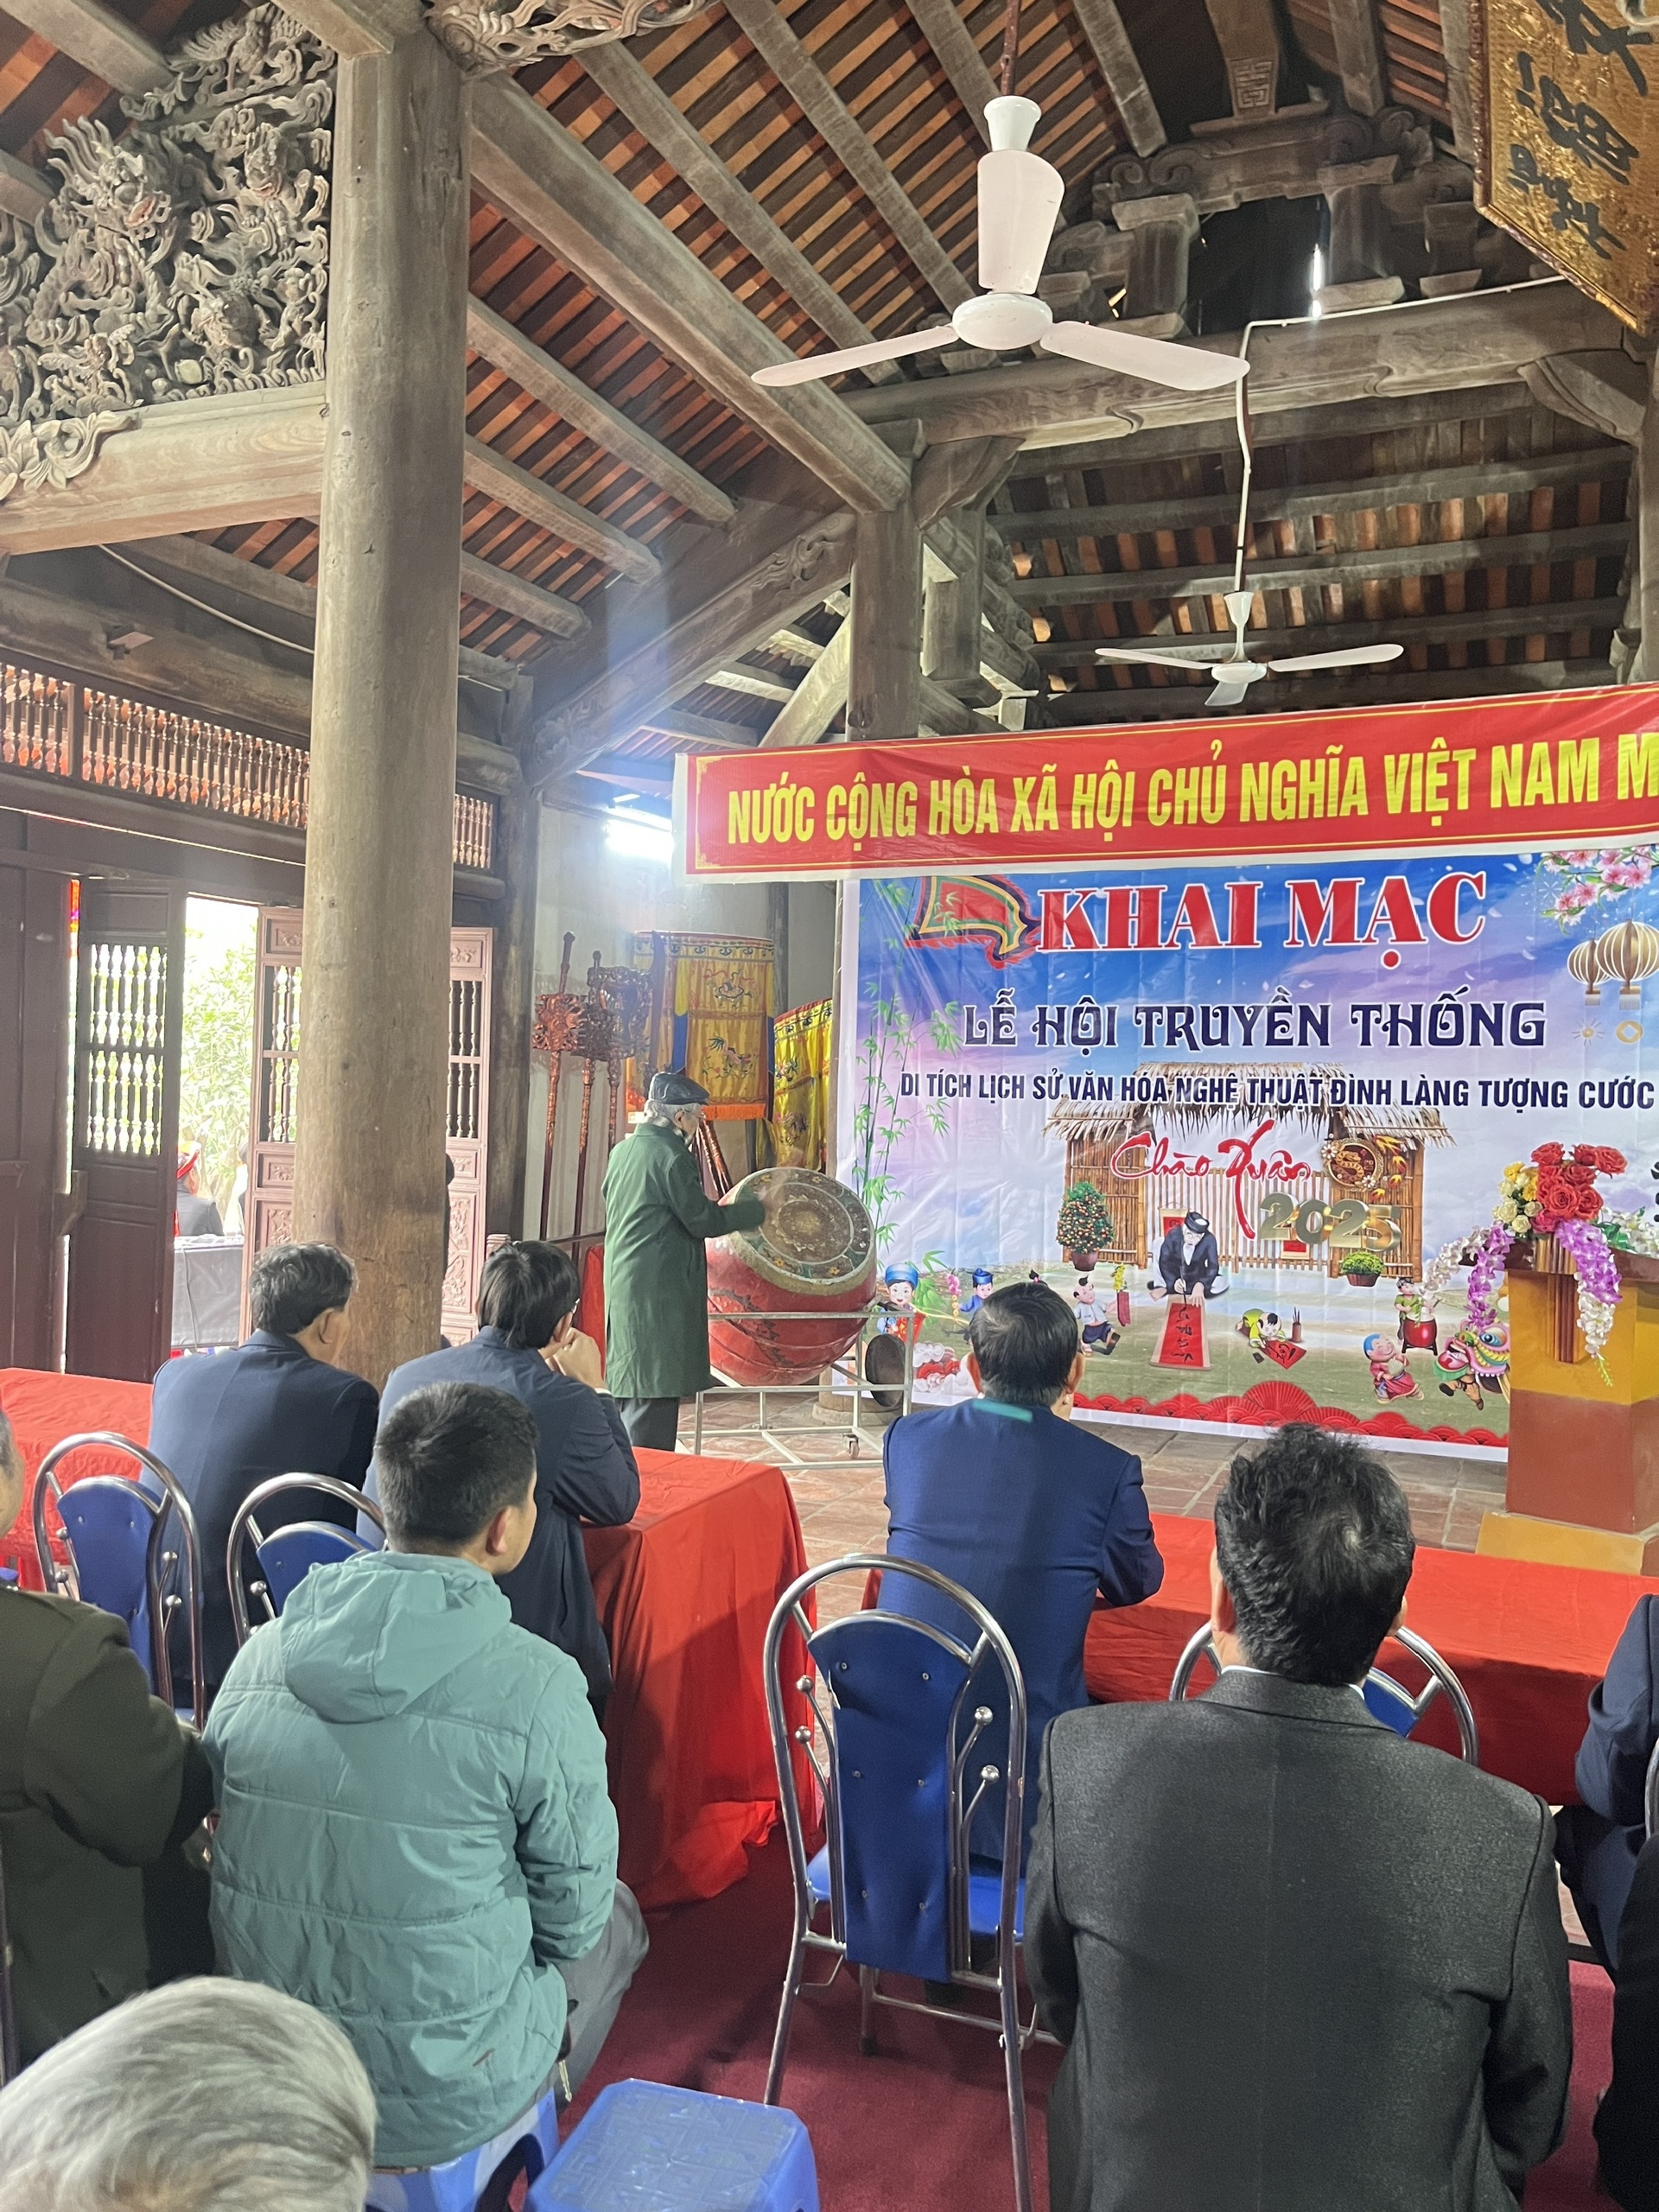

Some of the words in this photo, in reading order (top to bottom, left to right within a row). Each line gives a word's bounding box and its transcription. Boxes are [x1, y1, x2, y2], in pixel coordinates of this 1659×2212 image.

[728, 771, 816, 844] NƯỚC
[827, 772, 918, 851] CỘNG
[928, 766, 999, 836] HÒA
[1010, 763, 1060, 832] XÃ
[1071, 759, 1135, 842] HỘI
[1148, 739, 1227, 827] CHỦ
[1239, 744, 1370, 823] NGHĨA
[1383, 737, 1477, 827] VIỆT
[1491, 737, 1600, 809] NAM
[1036, 880, 1263, 953] KHAI
[1284, 870, 1486, 970] MẠC
[963, 988, 1017, 1047] LỄ
[1032, 995, 1118, 1056] HỘI
[1135, 986, 1332, 1052] TRUYỀN
[1351, 984, 1547, 1047] THỐNG
[900, 1072, 918, 1097] DI
[926, 1067, 971, 1099] TÍCH
[979, 1073, 1025, 1105] LỊCH
[1033, 1068, 1064, 1100] SỬ
[1069, 1069, 1114, 1103] VĂN
[1122, 1068, 1167, 1103] HÓA
[1176, 1072, 1238, 1109] NGHỆ
[1247, 1072, 1323, 1111] THUẬT
[1331, 1073, 1392, 1106] ĐÌNH
[1401, 1074, 1469, 1107] LÀNG
[1478, 1077, 1568, 1114] TƯỢNG
[1579, 1075, 1656, 1109] CƯỚC
[1112, 1132, 1211, 1179] Chào
[1217, 1118, 1312, 1239] Xuân
[1260, 1192, 1402, 1251] 2025
